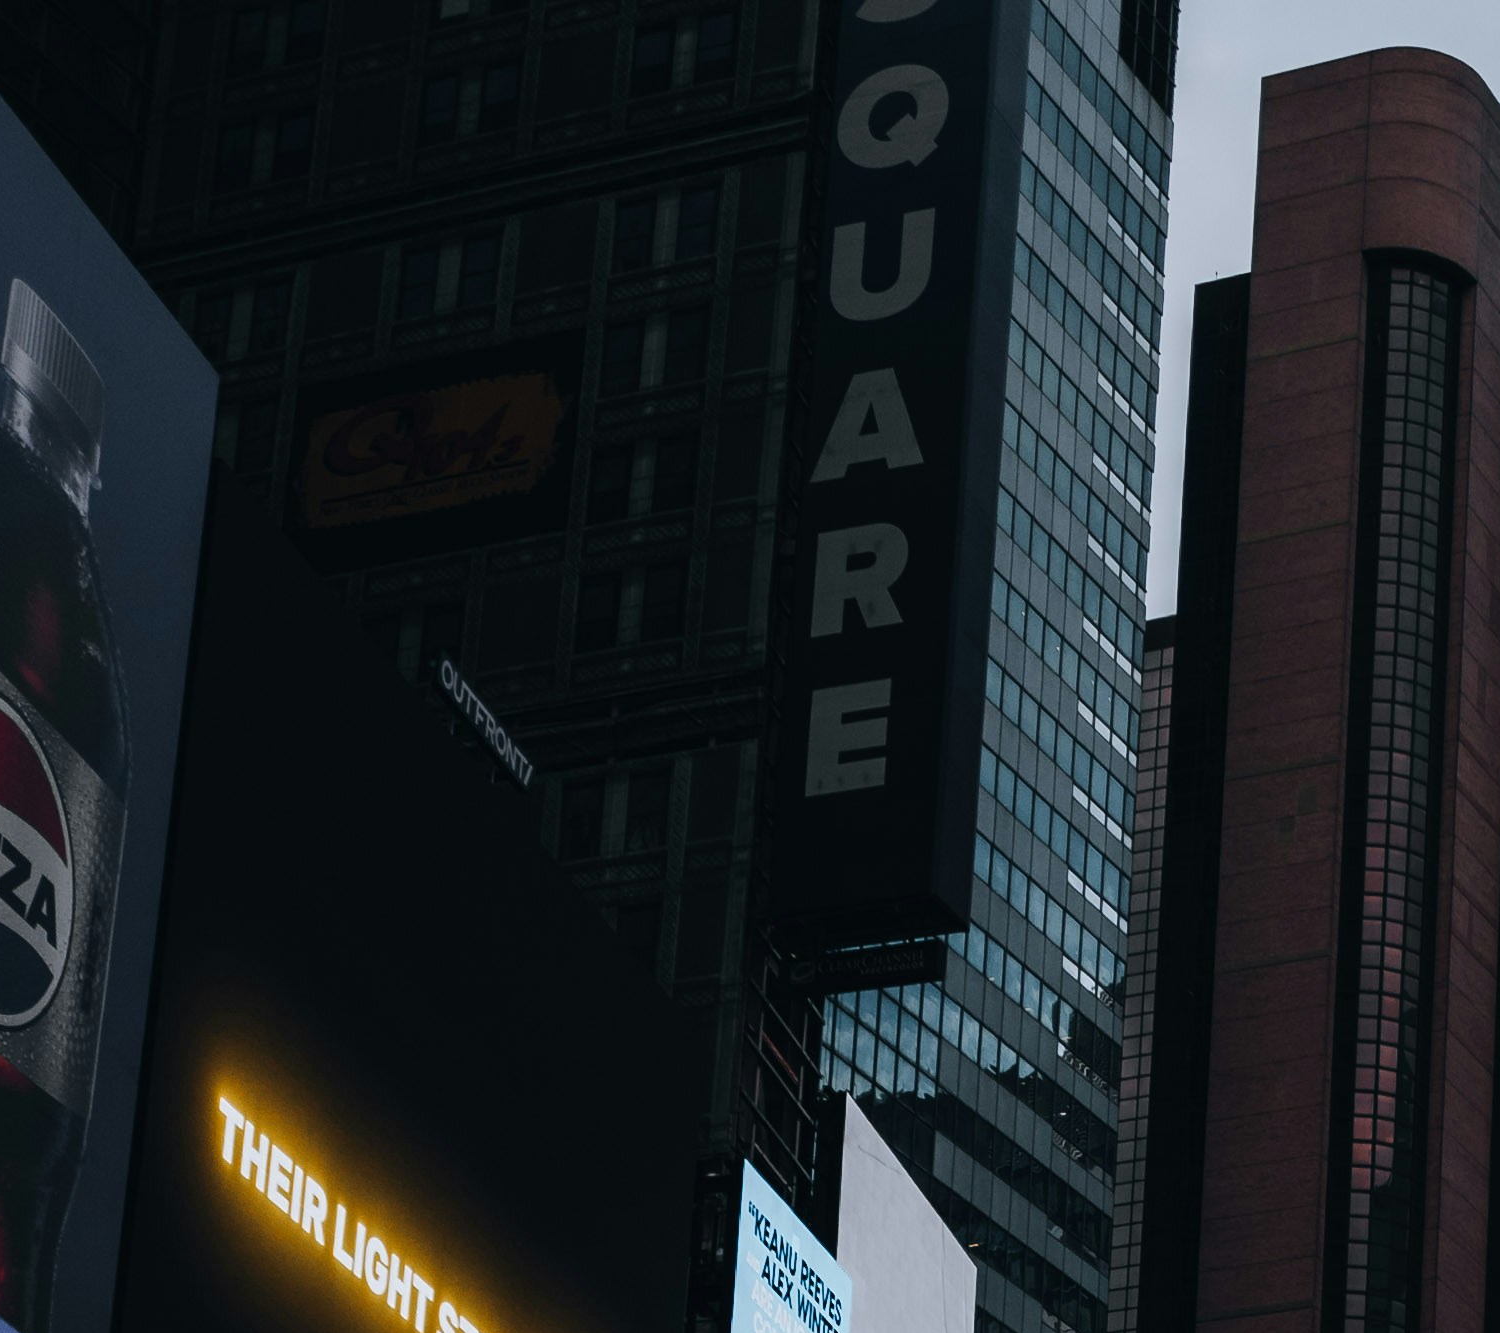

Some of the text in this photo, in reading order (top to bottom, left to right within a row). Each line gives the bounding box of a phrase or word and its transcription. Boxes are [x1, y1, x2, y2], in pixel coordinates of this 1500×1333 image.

[804, 0, 950, 798] QUARE
[218, 1096, 326, 1249] THEIR
[333, 1201, 435, 1333] LIGHT
[761, 1256, 793, 1309] ALEX
[800, 1259, 843, 1327] REEVES
